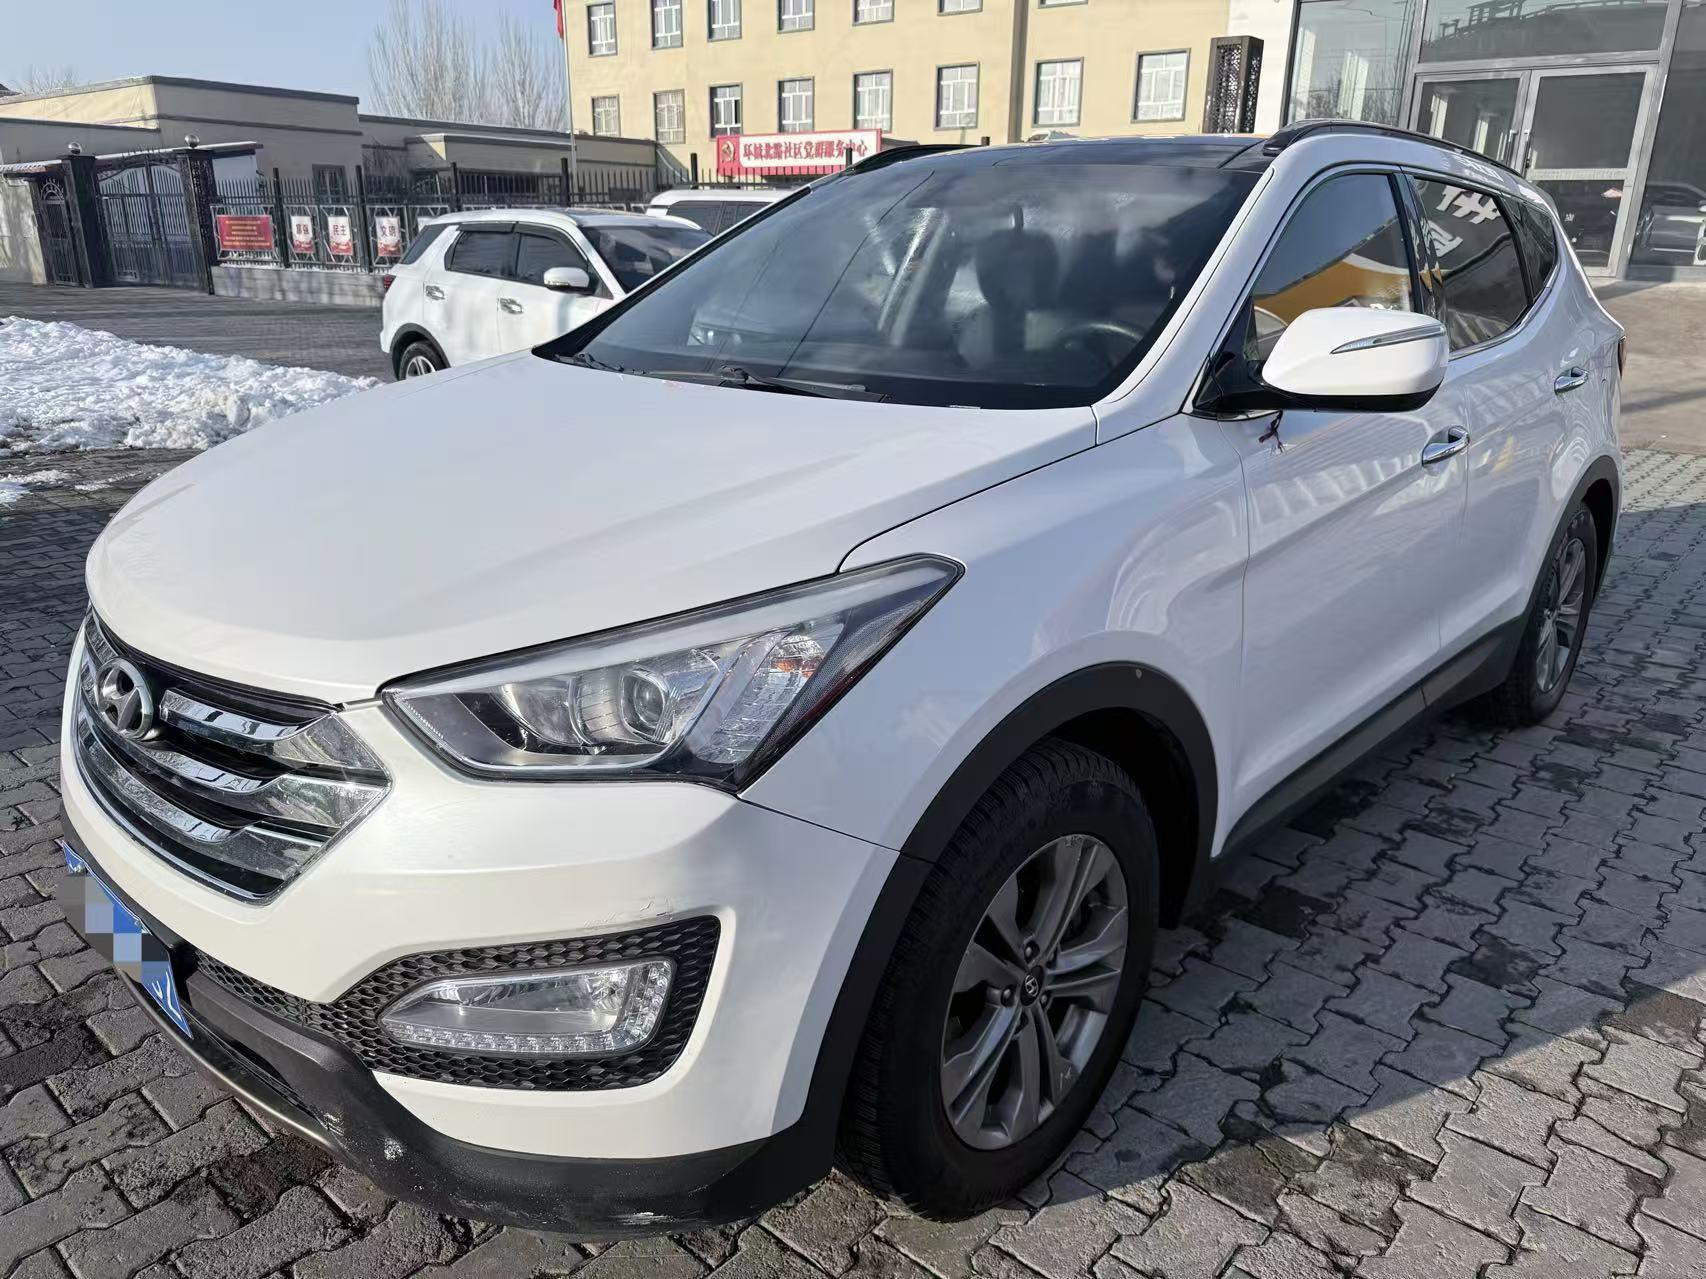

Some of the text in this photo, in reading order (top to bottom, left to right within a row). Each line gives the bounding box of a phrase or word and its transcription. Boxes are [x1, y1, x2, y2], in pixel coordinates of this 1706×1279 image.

[295, 223, 310, 235] 富强
[332, 224, 347, 236] 民主
[380, 226, 397, 238] 文明
